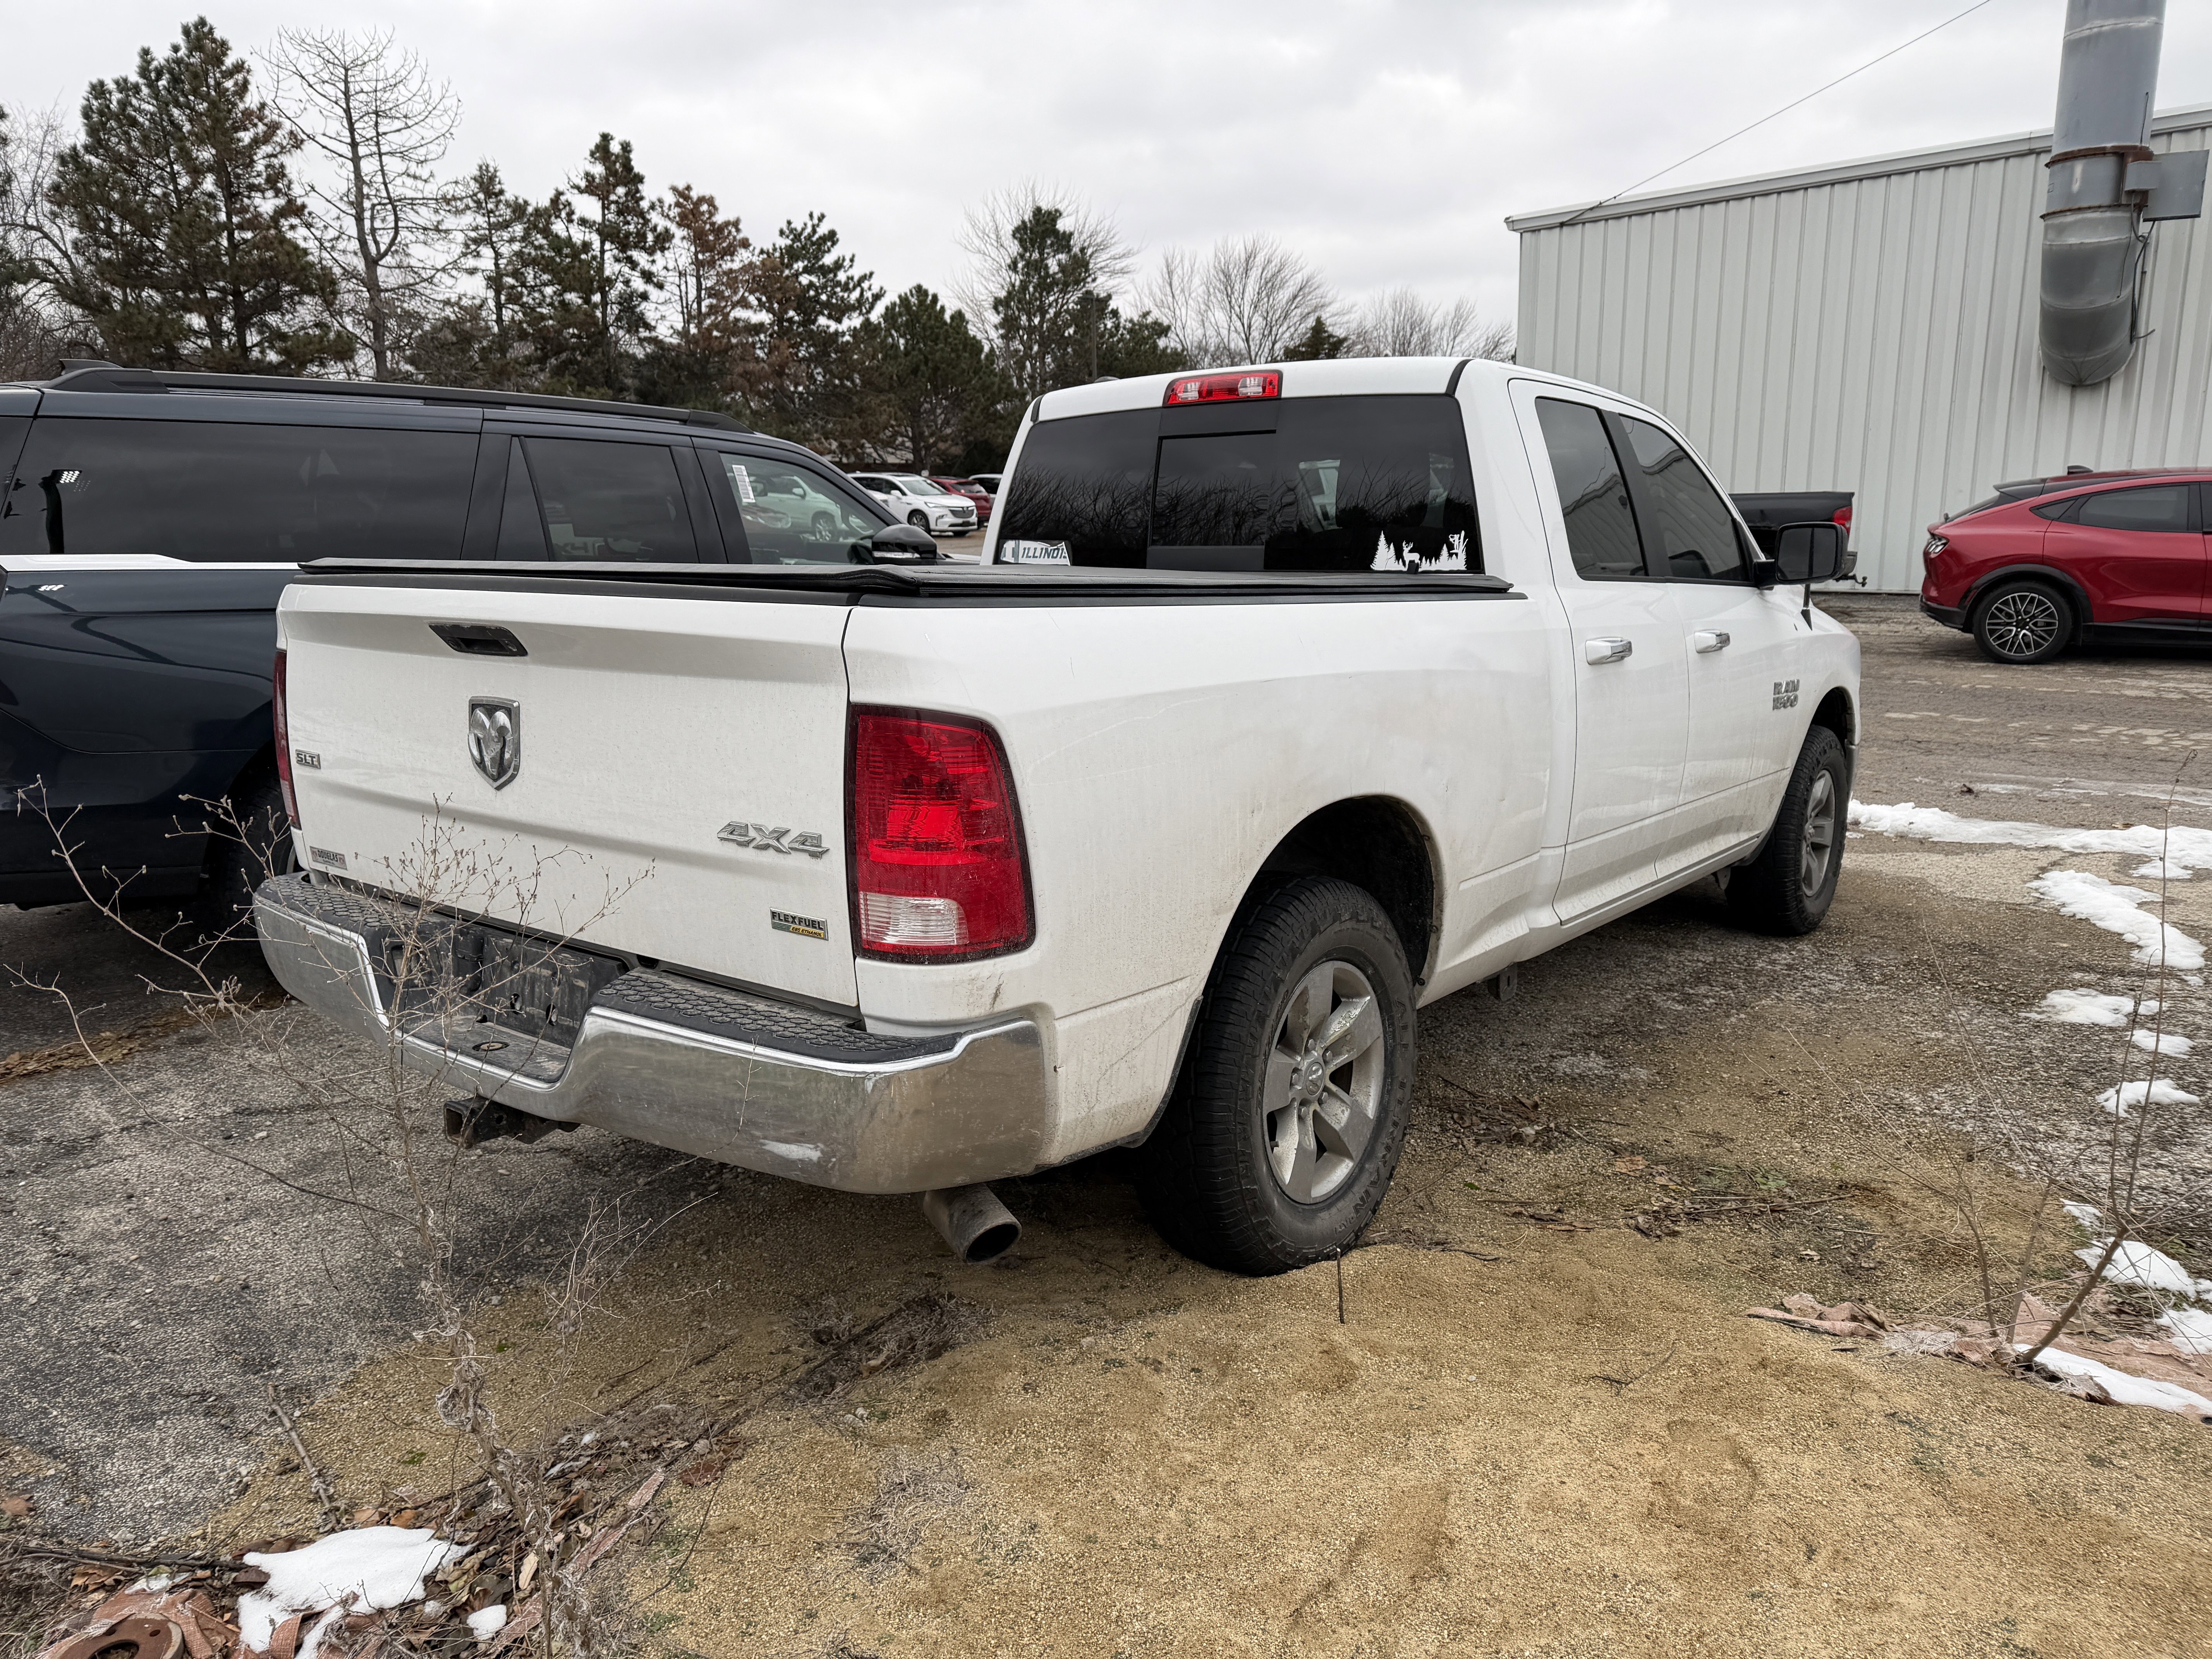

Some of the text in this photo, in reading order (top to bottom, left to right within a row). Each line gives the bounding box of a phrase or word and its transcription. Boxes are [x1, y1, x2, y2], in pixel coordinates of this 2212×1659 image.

[297, 752, 316, 766] SLT
[717, 821, 830, 860] 4X4
[771, 911, 824, 930] FLEXFUEL
